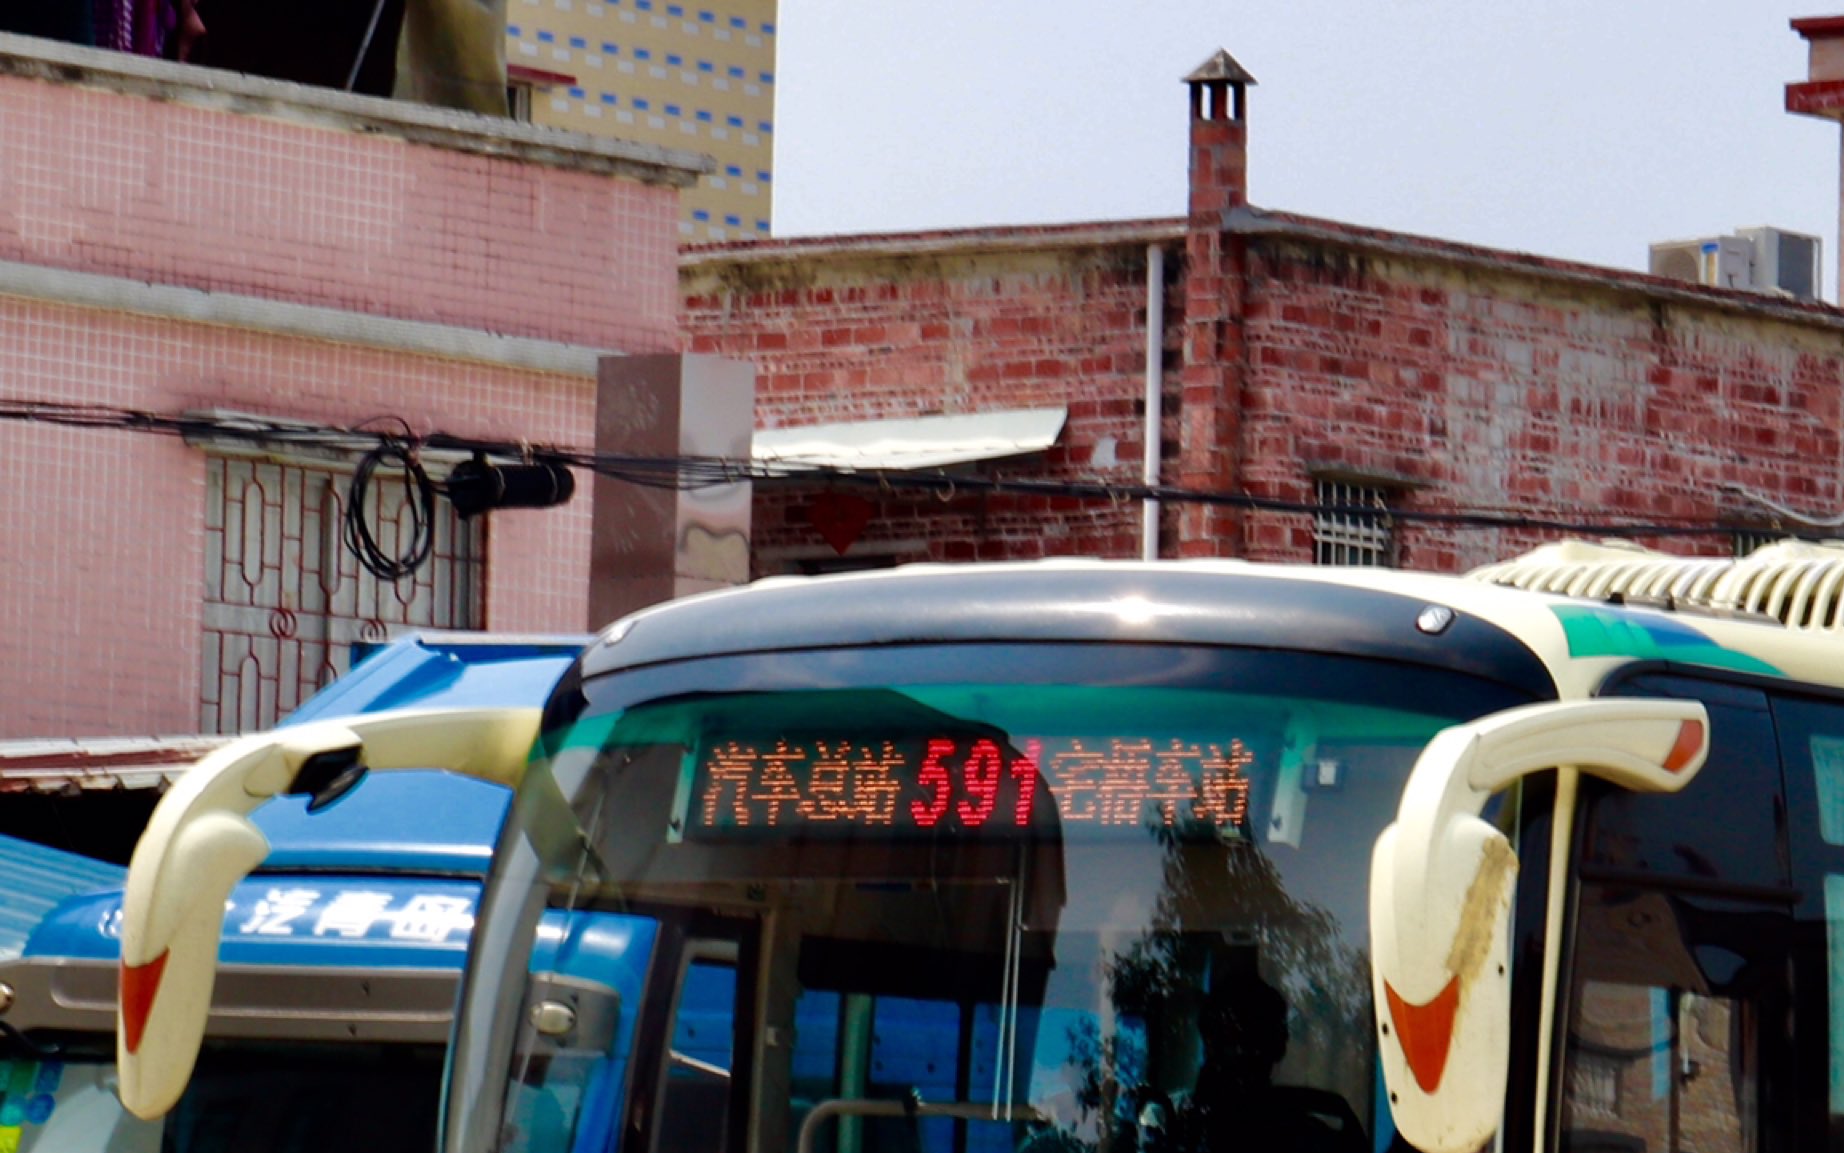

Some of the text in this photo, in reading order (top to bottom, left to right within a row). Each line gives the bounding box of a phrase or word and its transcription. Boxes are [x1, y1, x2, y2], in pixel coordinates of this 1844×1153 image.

[703, 741, 906, 826] 汽车总站
[911, 738, 1041, 826] 591
[225, 888, 476, 940] 汽青岛
